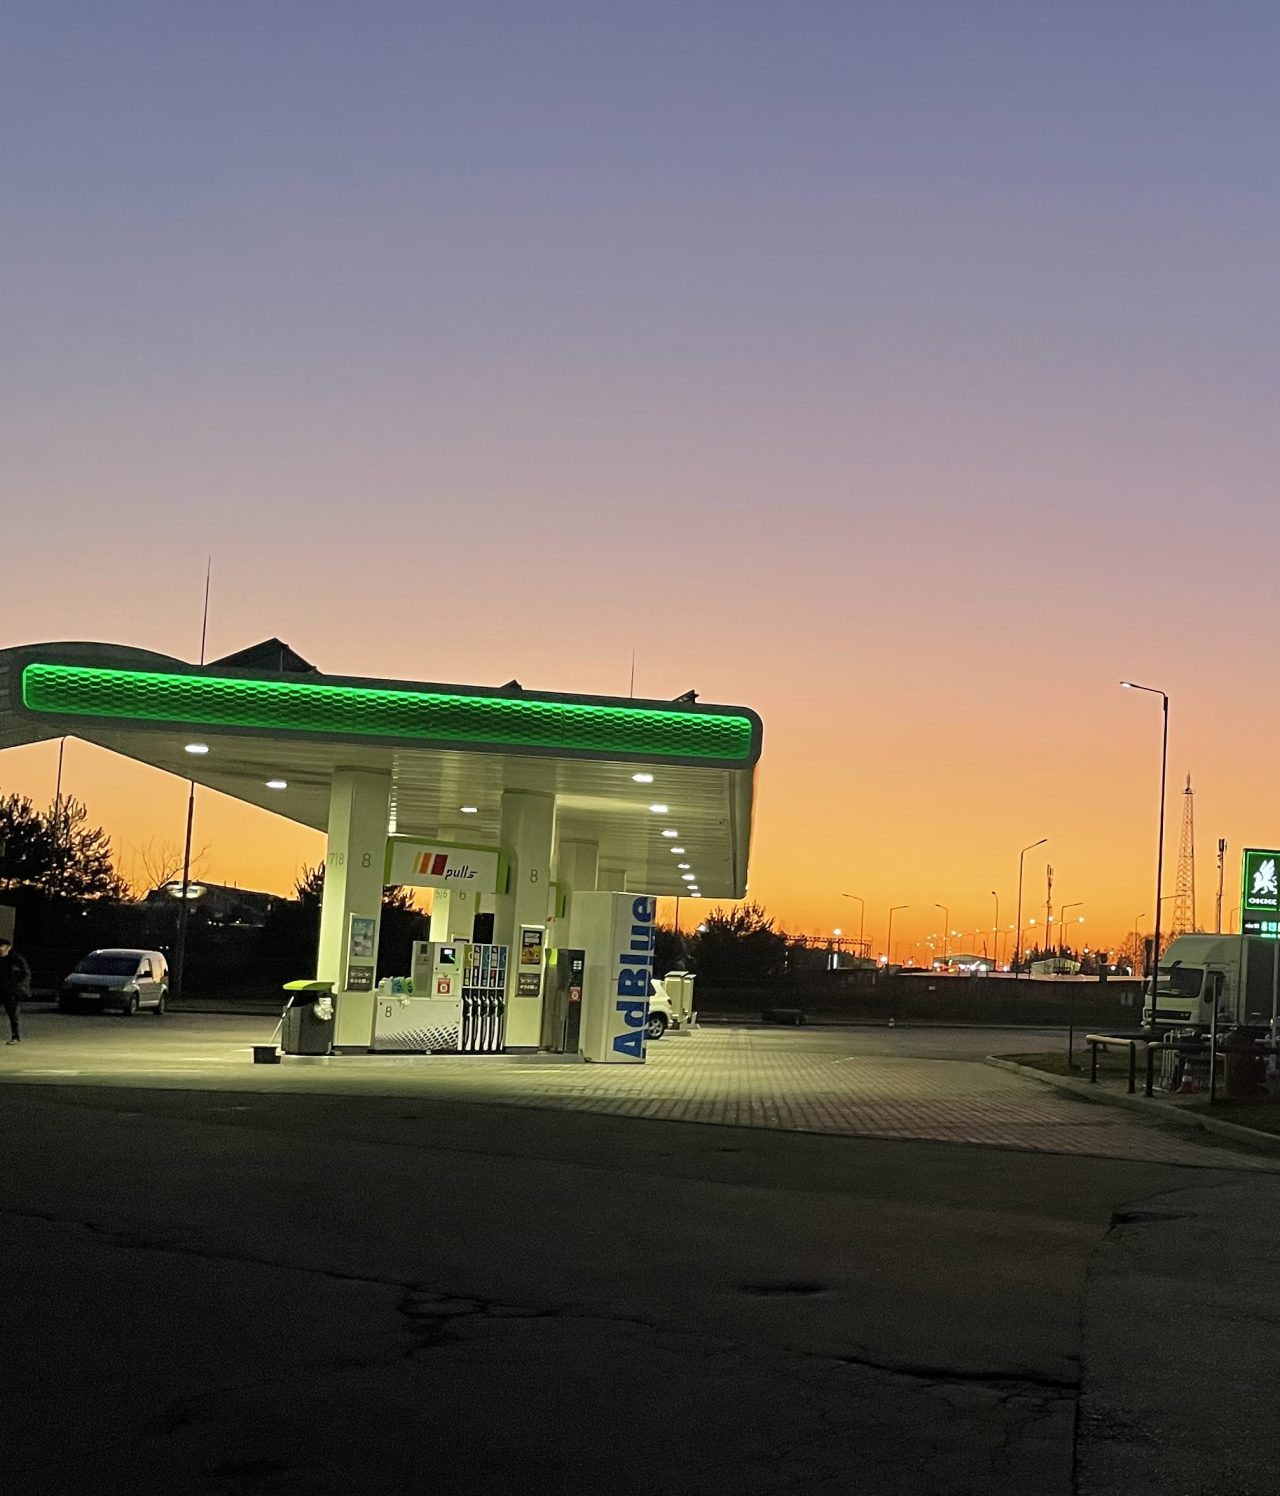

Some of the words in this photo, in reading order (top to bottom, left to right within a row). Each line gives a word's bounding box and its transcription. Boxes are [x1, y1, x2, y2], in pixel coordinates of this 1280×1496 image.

[361, 852, 372, 868] 8
[444, 865, 478, 881] pulls
[529, 868, 538, 883] 8
[612, 896, 657, 1059] AdBlue
[384, 1005, 393, 1018] 8
